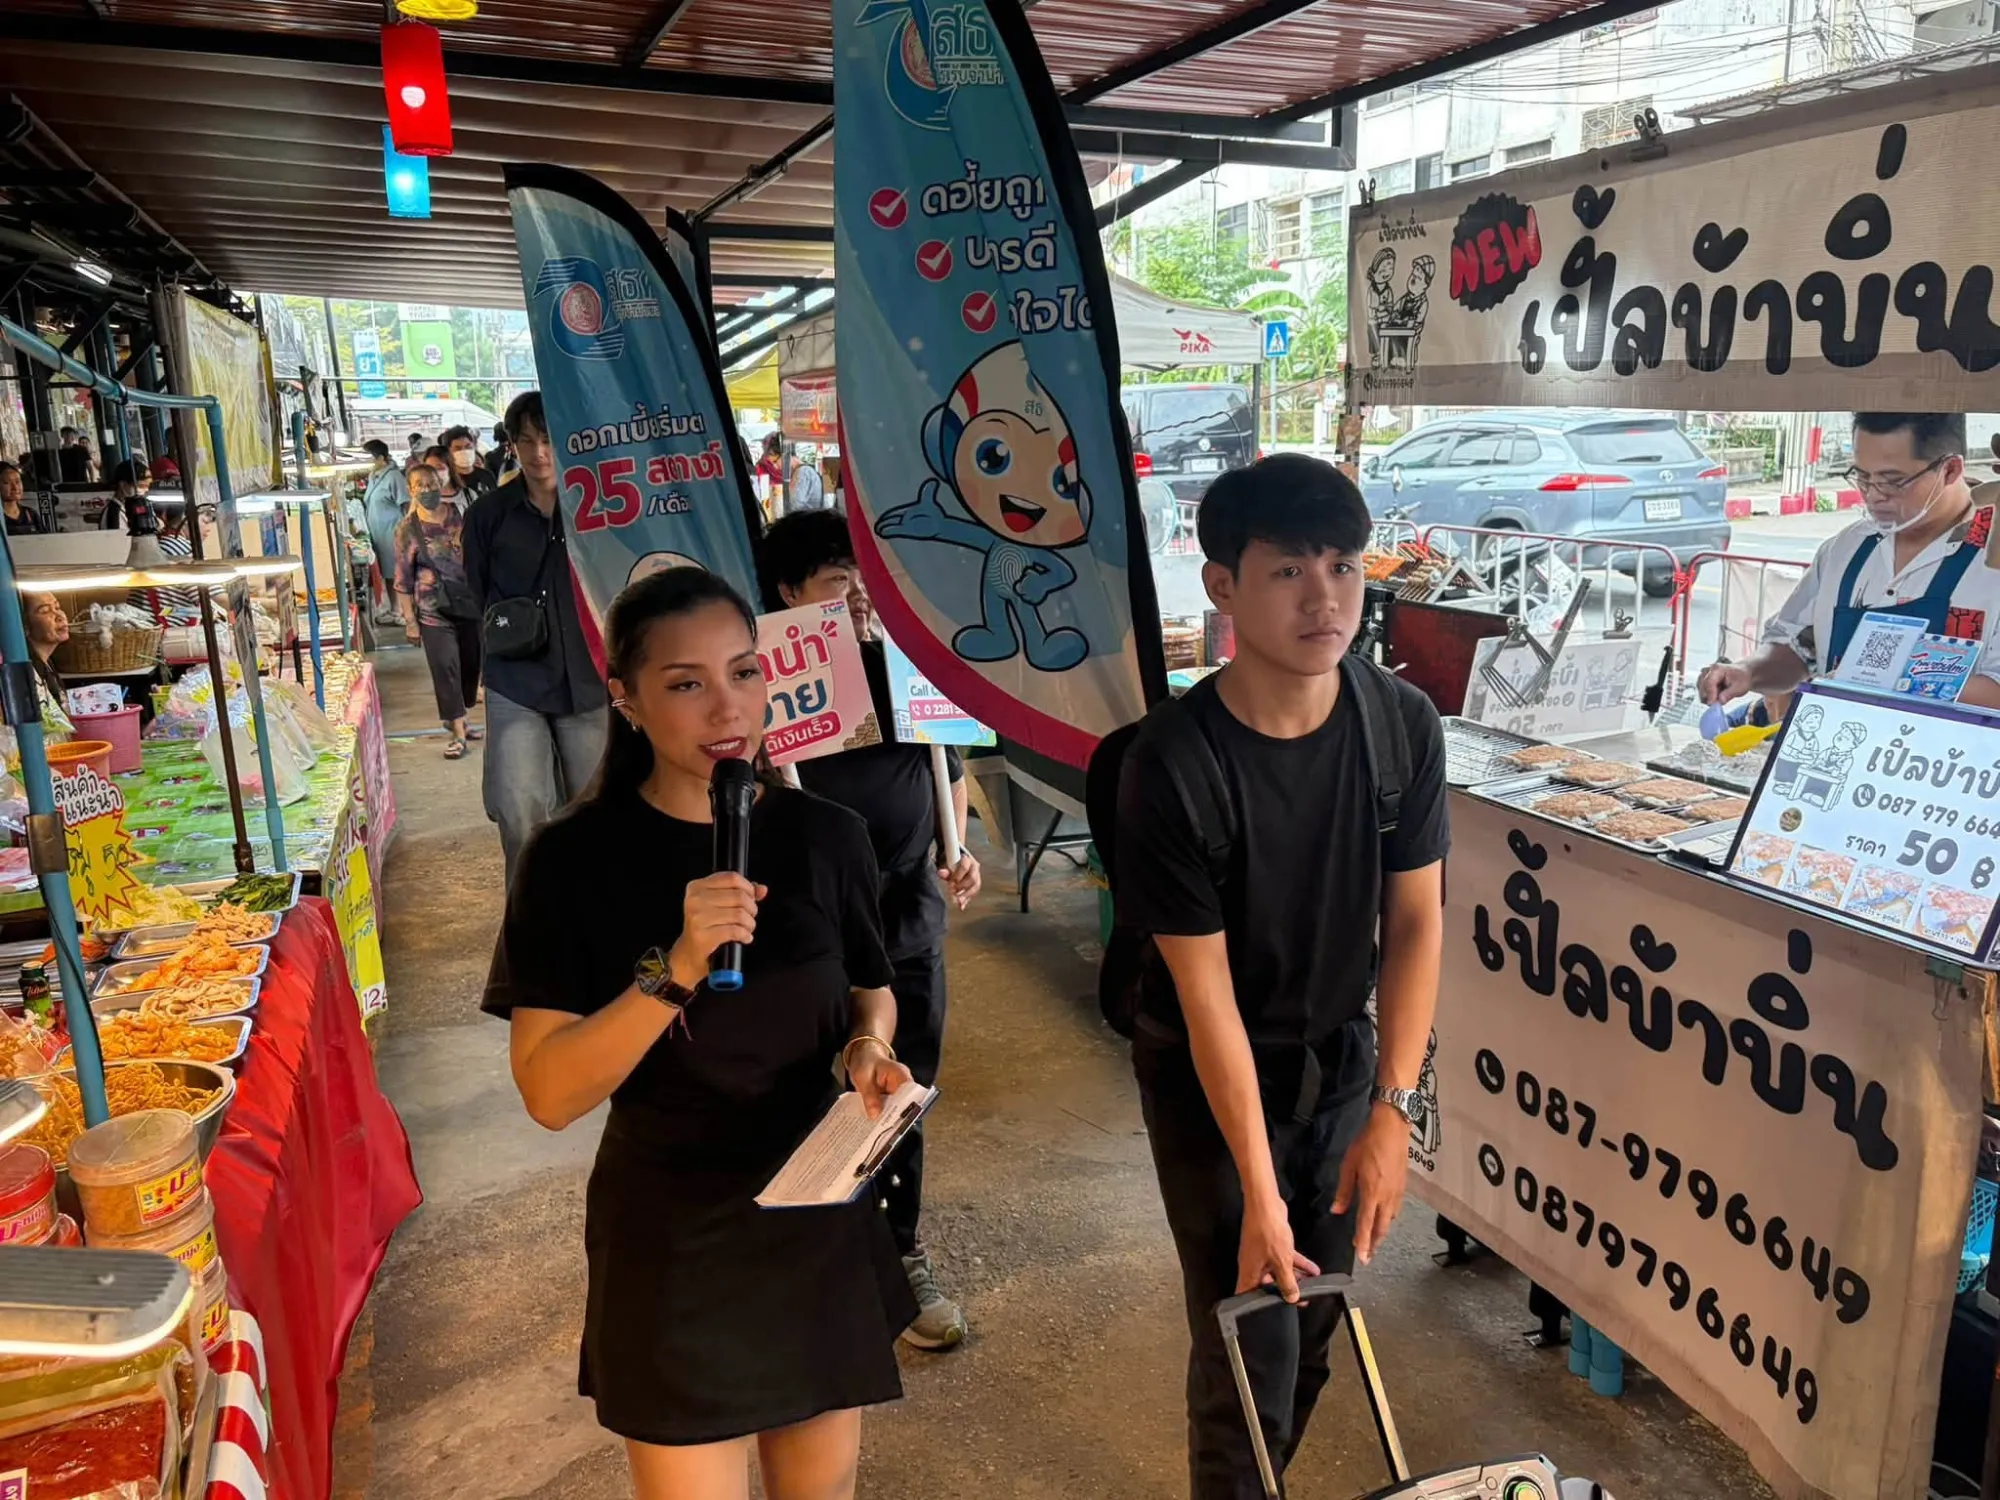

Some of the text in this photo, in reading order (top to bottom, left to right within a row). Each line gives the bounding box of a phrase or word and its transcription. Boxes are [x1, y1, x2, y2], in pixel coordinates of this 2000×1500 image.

[1450, 205, 1542, 300] NEW
[1180, 342, 1211, 353] PIKA
[563, 456, 643, 533] 25
[910, 684, 928, 696] Call
[766, 717, 834, 752] ด้เงินเร็ว
[53, 766, 99, 804] สินค้า
[65, 784, 121, 821] แนะนำ
[1878, 793, 1916, 816] 087
[1922, 803, 1959, 828] 979
[1846, 834, 1887, 858] ราคา
[1896, 829, 1959, 876] 50
[1474, 829, 1899, 1171] เปิ้ลบ้าบิ่น
[1516, 1071, 1870, 1324] 087-9796649
[1515, 1167, 1818, 1424] 0879796649
